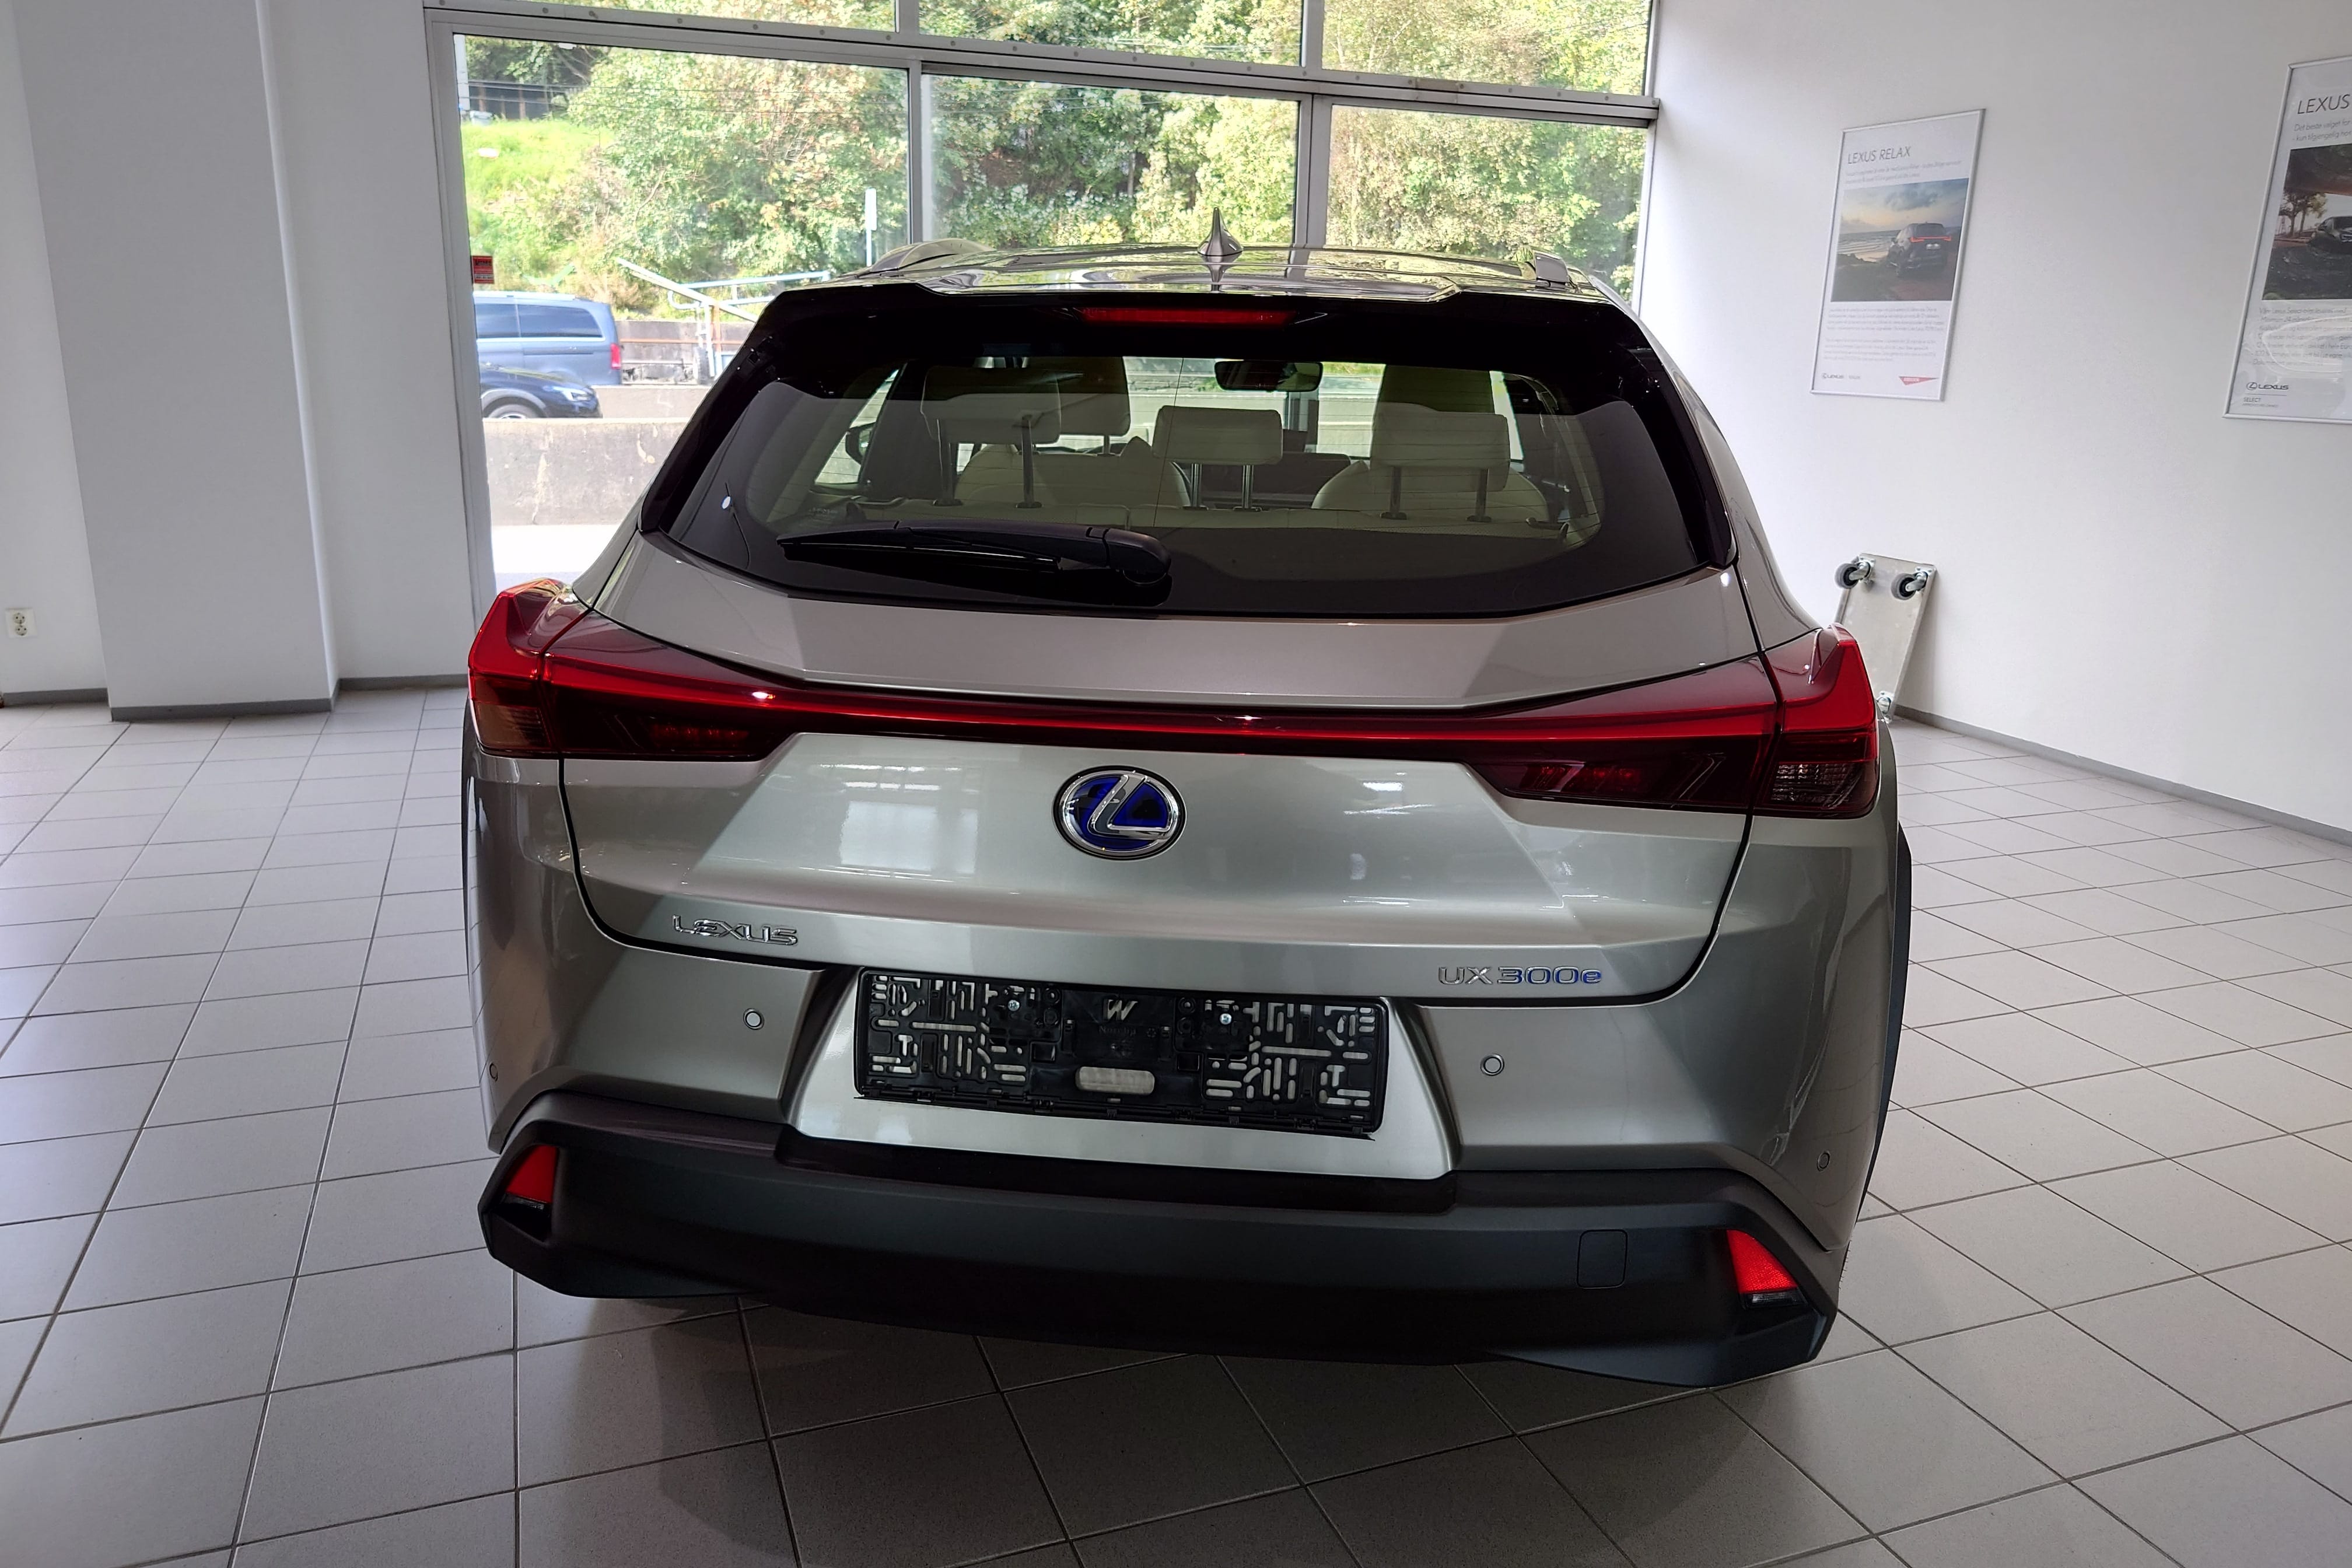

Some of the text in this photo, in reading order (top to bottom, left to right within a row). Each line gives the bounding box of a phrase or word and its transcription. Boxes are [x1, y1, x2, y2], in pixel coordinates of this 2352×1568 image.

[2297, 93, 2351, 115] LEXUS
[1847, 146, 1912, 164] LEXUS RELAX
[672, 914, 798, 946] LEXUS
